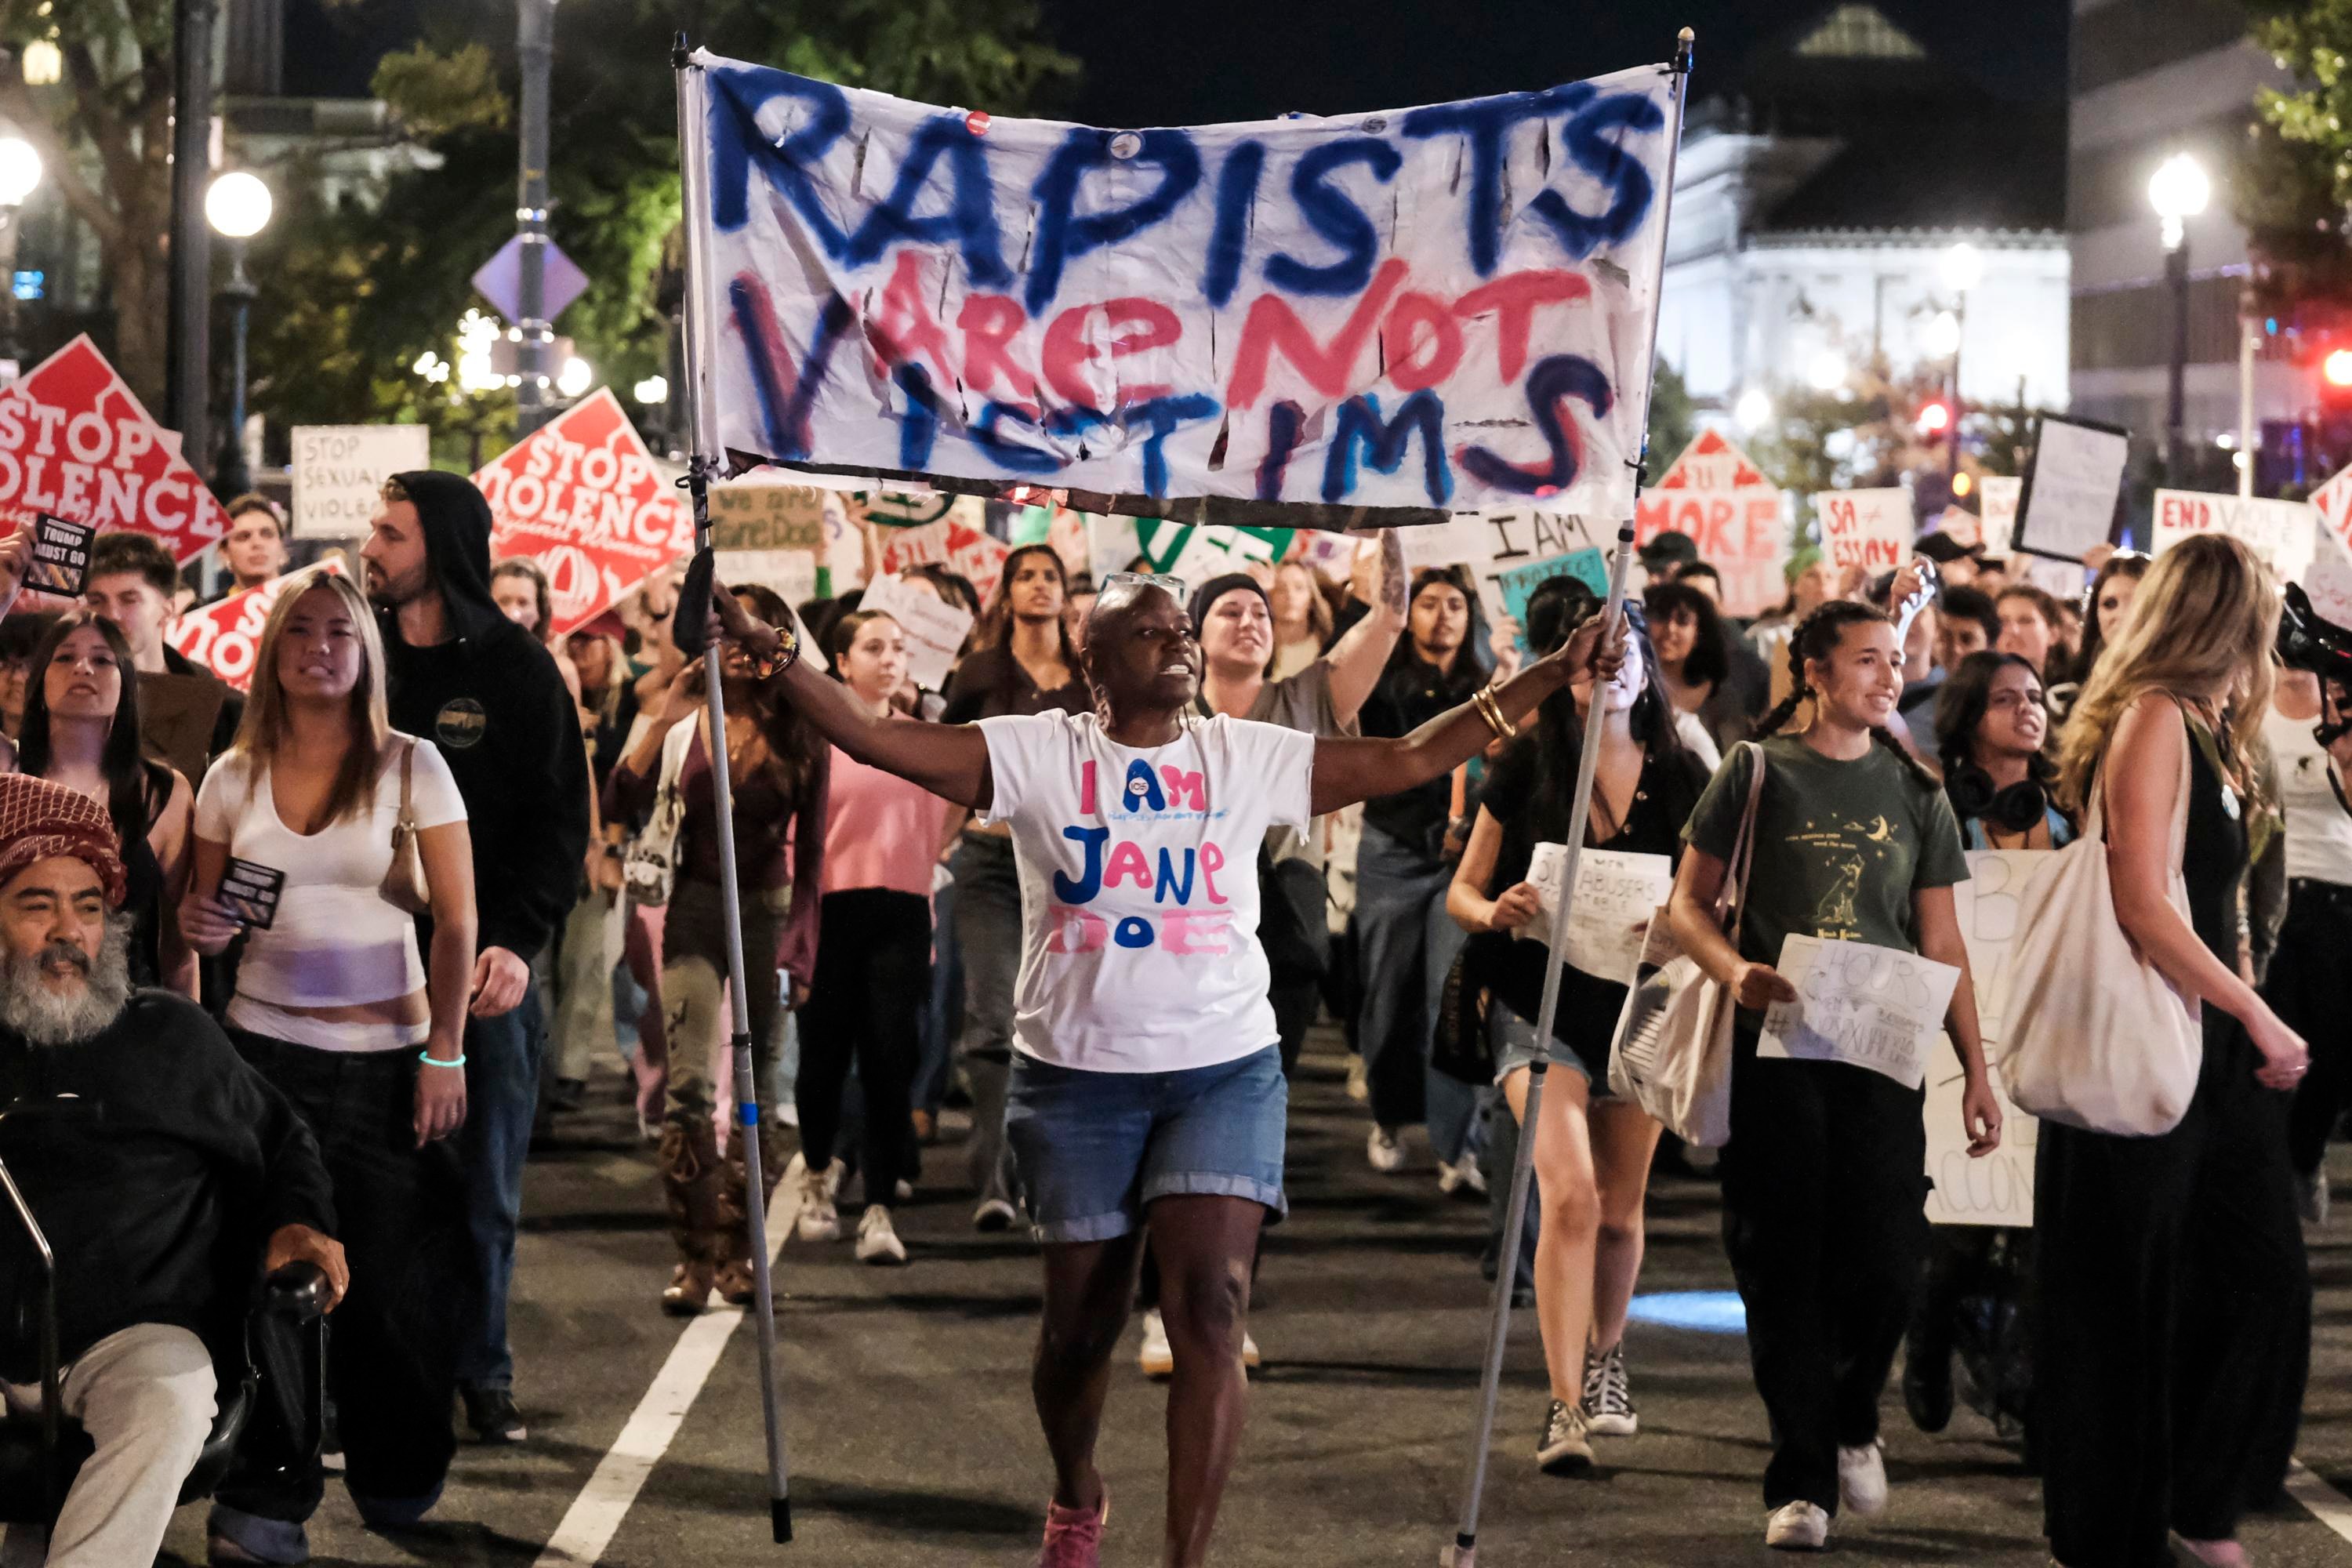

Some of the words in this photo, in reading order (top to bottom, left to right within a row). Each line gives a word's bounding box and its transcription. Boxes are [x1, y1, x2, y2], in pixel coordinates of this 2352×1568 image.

[709, 66, 1666, 315] RAPISTS
[1227, 257, 1592, 409] NOT
[0, 397, 154, 470] STOP
[304, 435, 360, 461] STOP
[304, 466, 386, 489] SEXUAL
[525, 434, 648, 495] STOP
[44, 525, 82, 546] TRUMP
[1487, 515, 1530, 561] I
[1534, 510, 1597, 554] AM
[1635, 497, 1779, 561] MORE
[1828, 500, 1857, 535] SA
[2162, 497, 2210, 529] END
[34, 542, 68, 561] MUST
[70, 550, 85, 566] GO
[1833, 539, 1900, 568] ESSAY
[1079, 759, 1097, 815] I
[1123, 757, 1206, 813] AM
[1046, 905, 1234, 956] DOE
[1828, 946, 1932, 1011] HOURS
